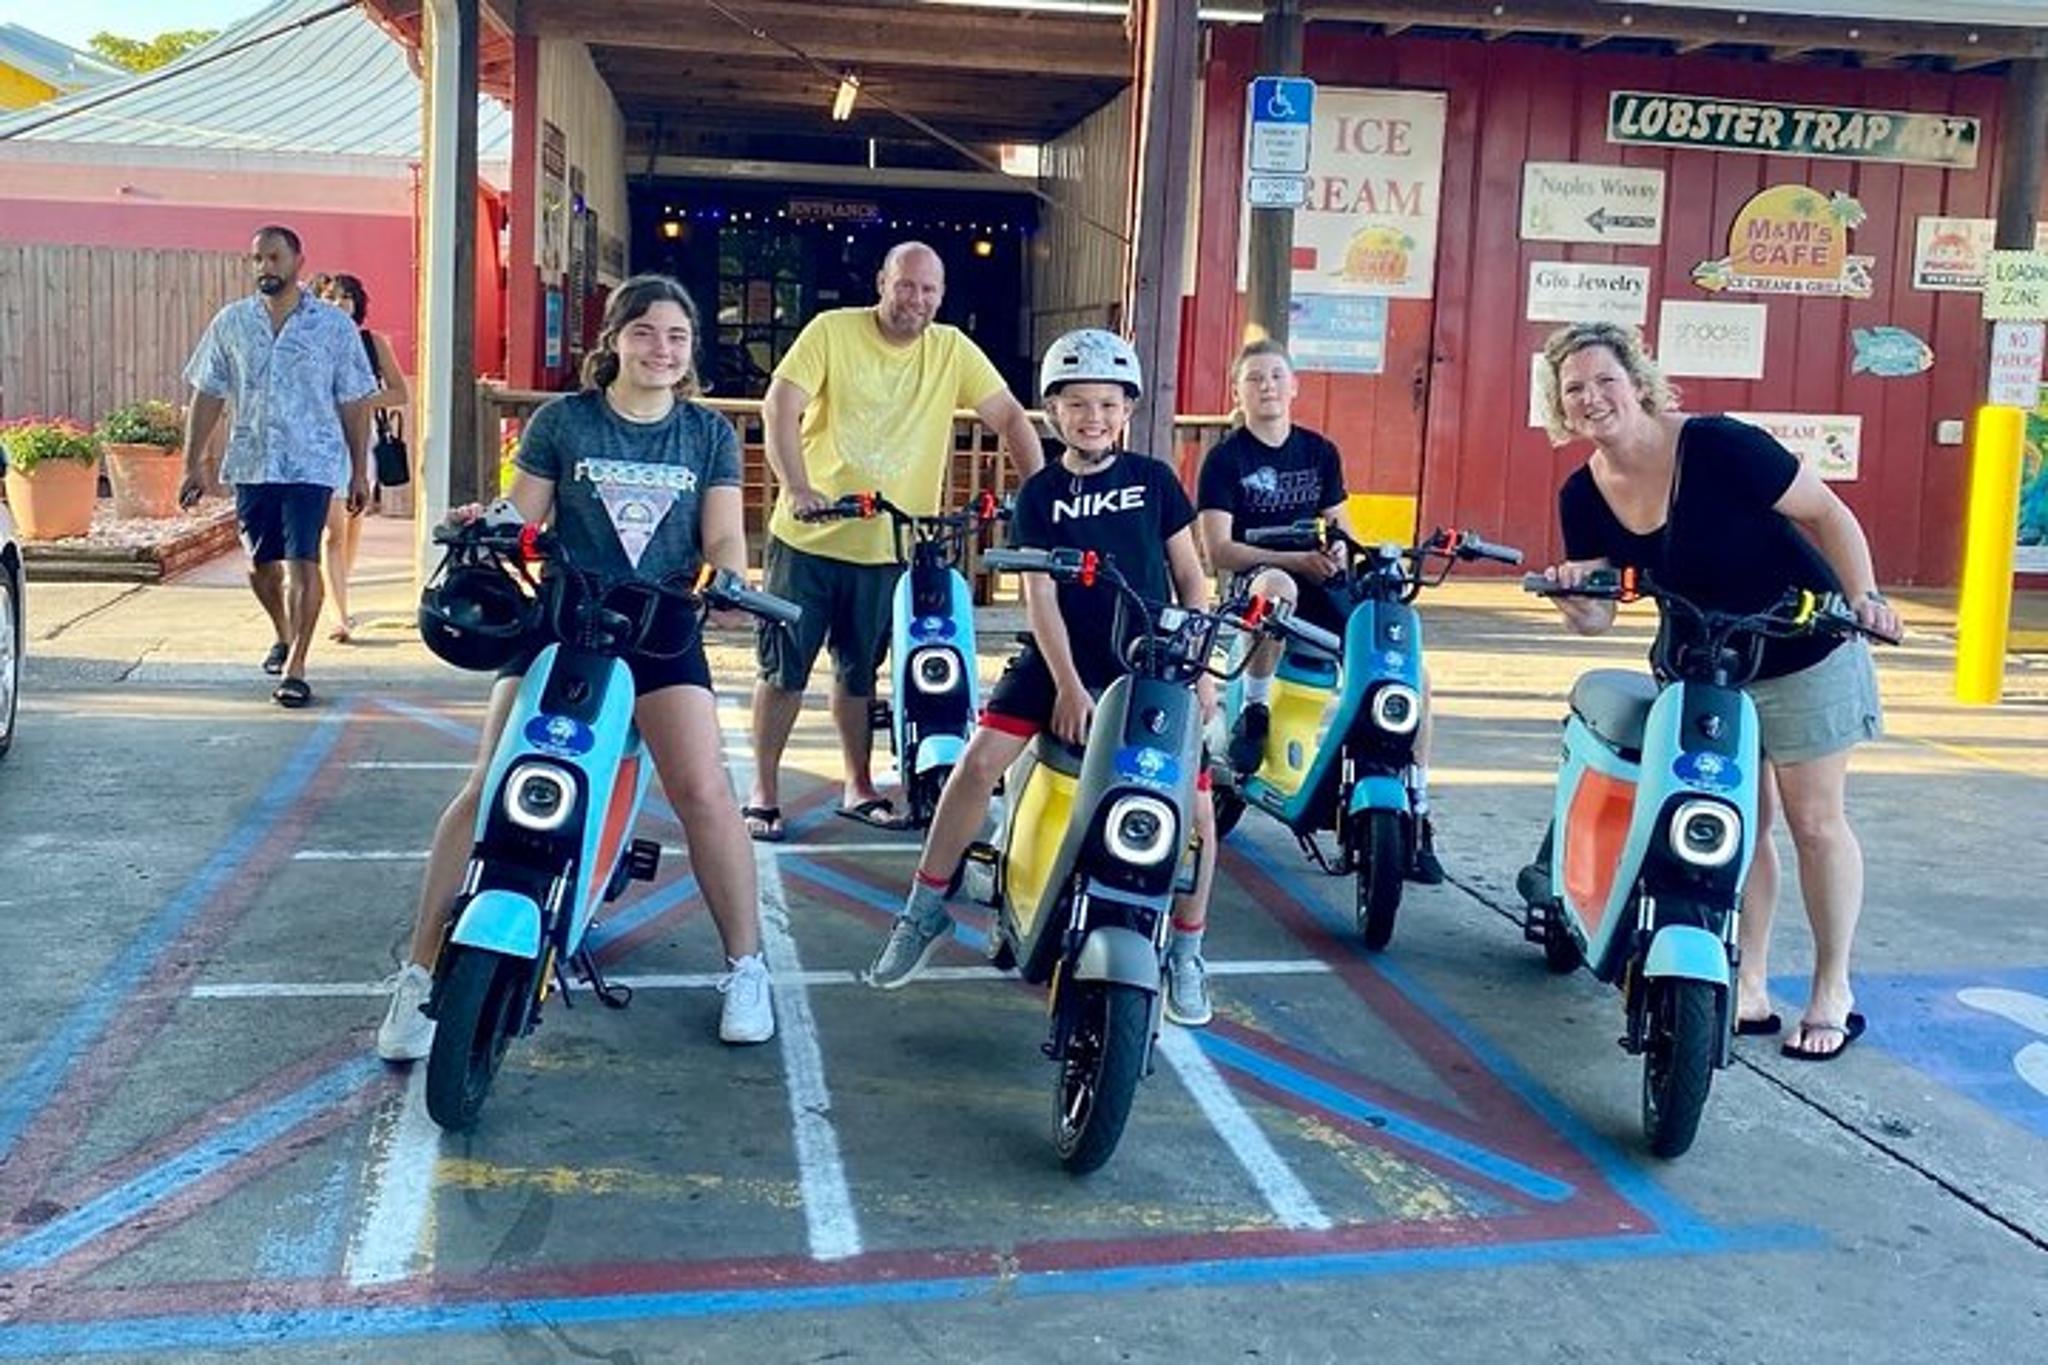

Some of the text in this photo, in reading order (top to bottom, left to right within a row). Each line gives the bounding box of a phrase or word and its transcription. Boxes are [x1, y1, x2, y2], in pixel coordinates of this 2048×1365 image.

[1333, 116, 1412, 156] ICE
[1620, 98, 1968, 156] LOBSTER TRAP ART
[1541, 176, 1594, 197] Naples
[1750, 244, 1828, 266] CAFE
[1572, 272, 1643, 297] Jewelry
[2008, 331, 2029, 348] NO
[1052, 485, 1147, 523] NIKE
